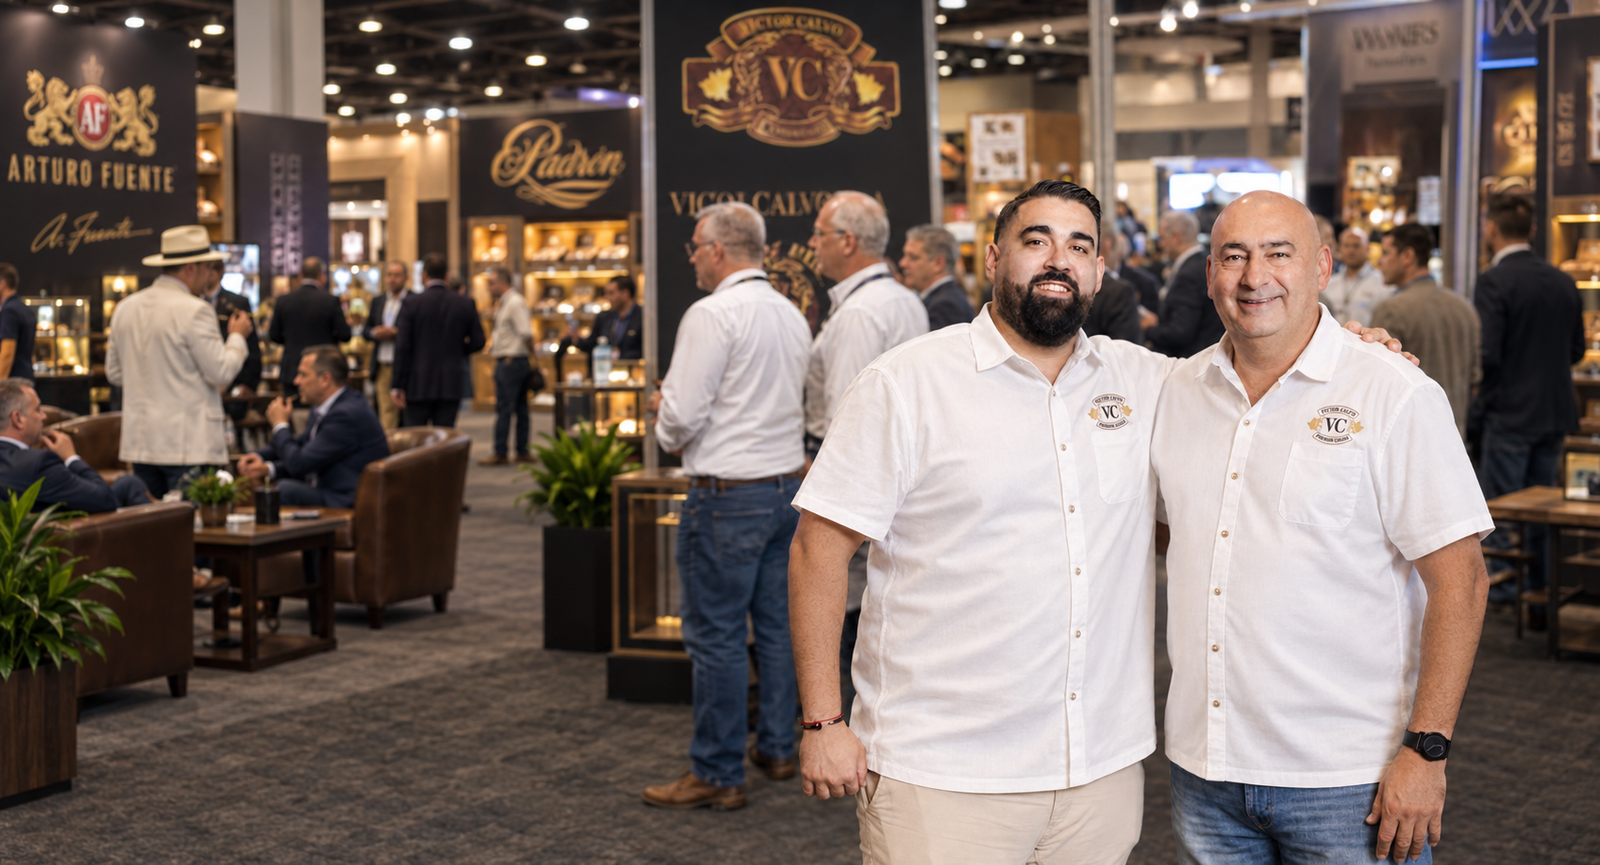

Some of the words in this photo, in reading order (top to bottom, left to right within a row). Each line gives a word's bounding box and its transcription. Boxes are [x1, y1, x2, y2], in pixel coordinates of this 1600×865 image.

[738, 15, 794, 36] VICTOR
[796, 15, 844, 37] CALVO
[764, 56, 823, 101] VC
[79, 100, 108, 135] AF
[8, 153, 92, 188] ARTURO
[101, 160, 175, 194] FUENTE
[1101, 404, 1120, 419] VC
[1325, 417, 1348, 433] VC
